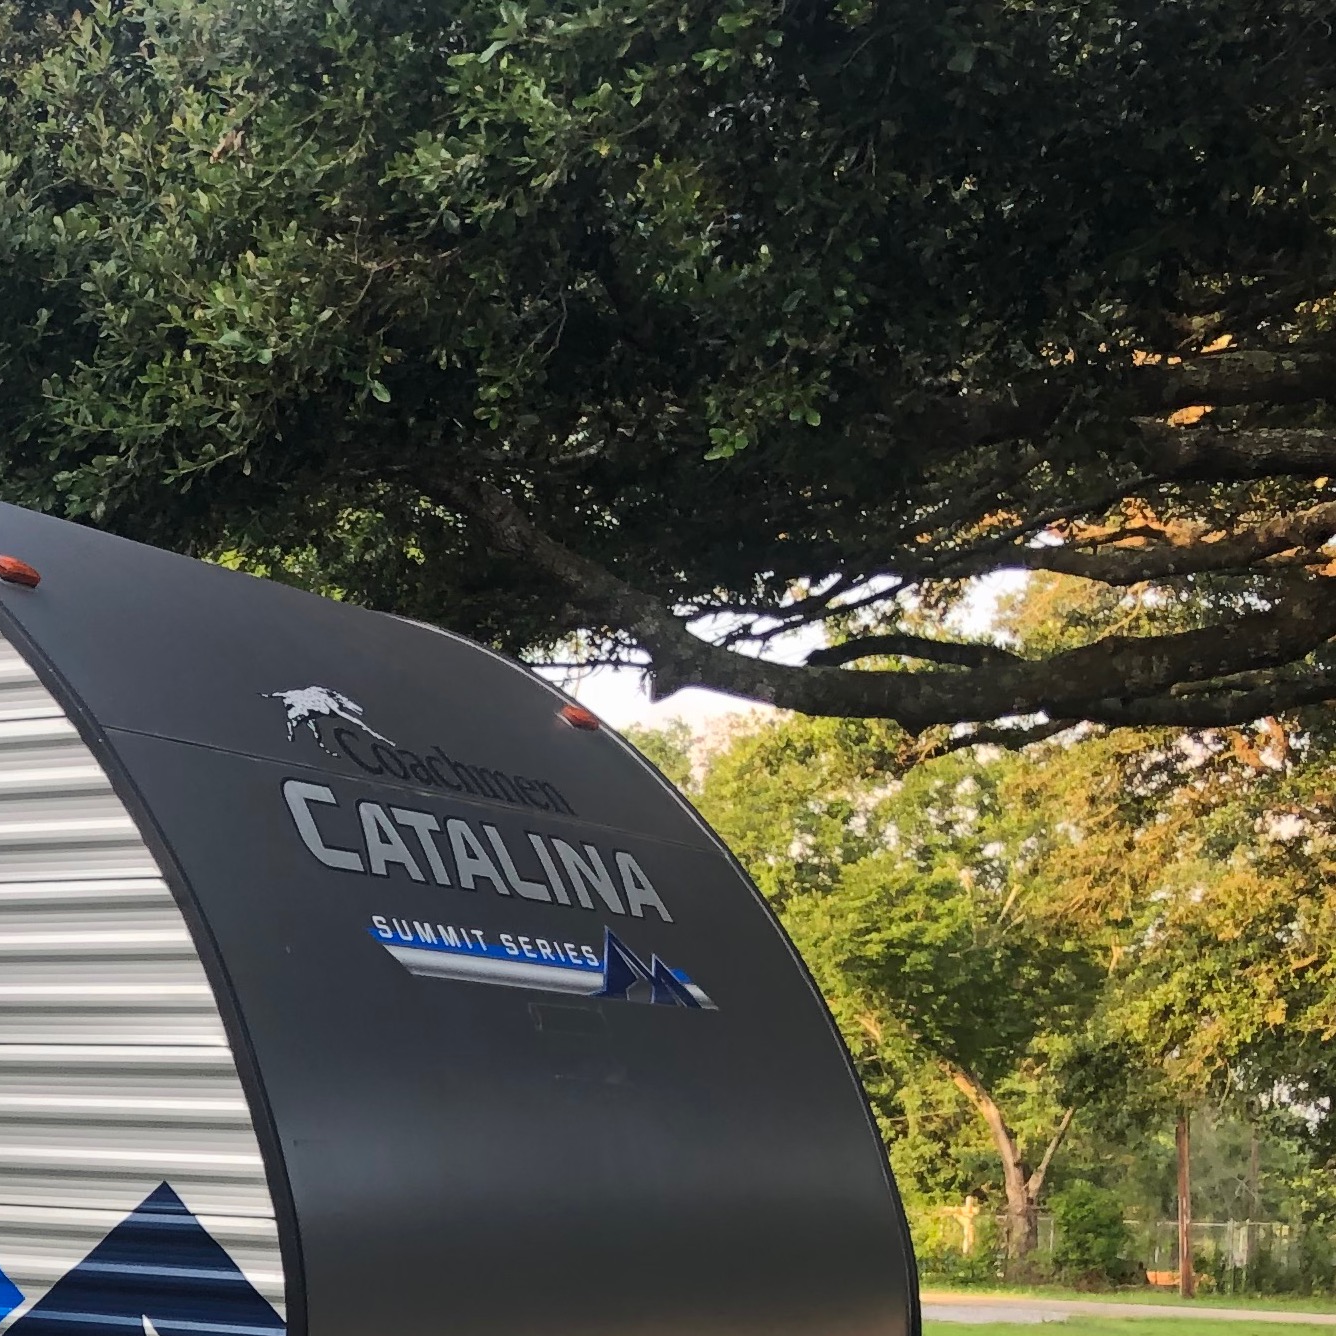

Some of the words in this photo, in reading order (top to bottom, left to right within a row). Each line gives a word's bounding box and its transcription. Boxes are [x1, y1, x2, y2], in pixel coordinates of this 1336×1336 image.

[333, 727, 576, 815] Coachmen
[281, 777, 673, 923] CATALINA
[371, 915, 488, 952] SUMMIT
[500, 933, 599, 967] SERIES
